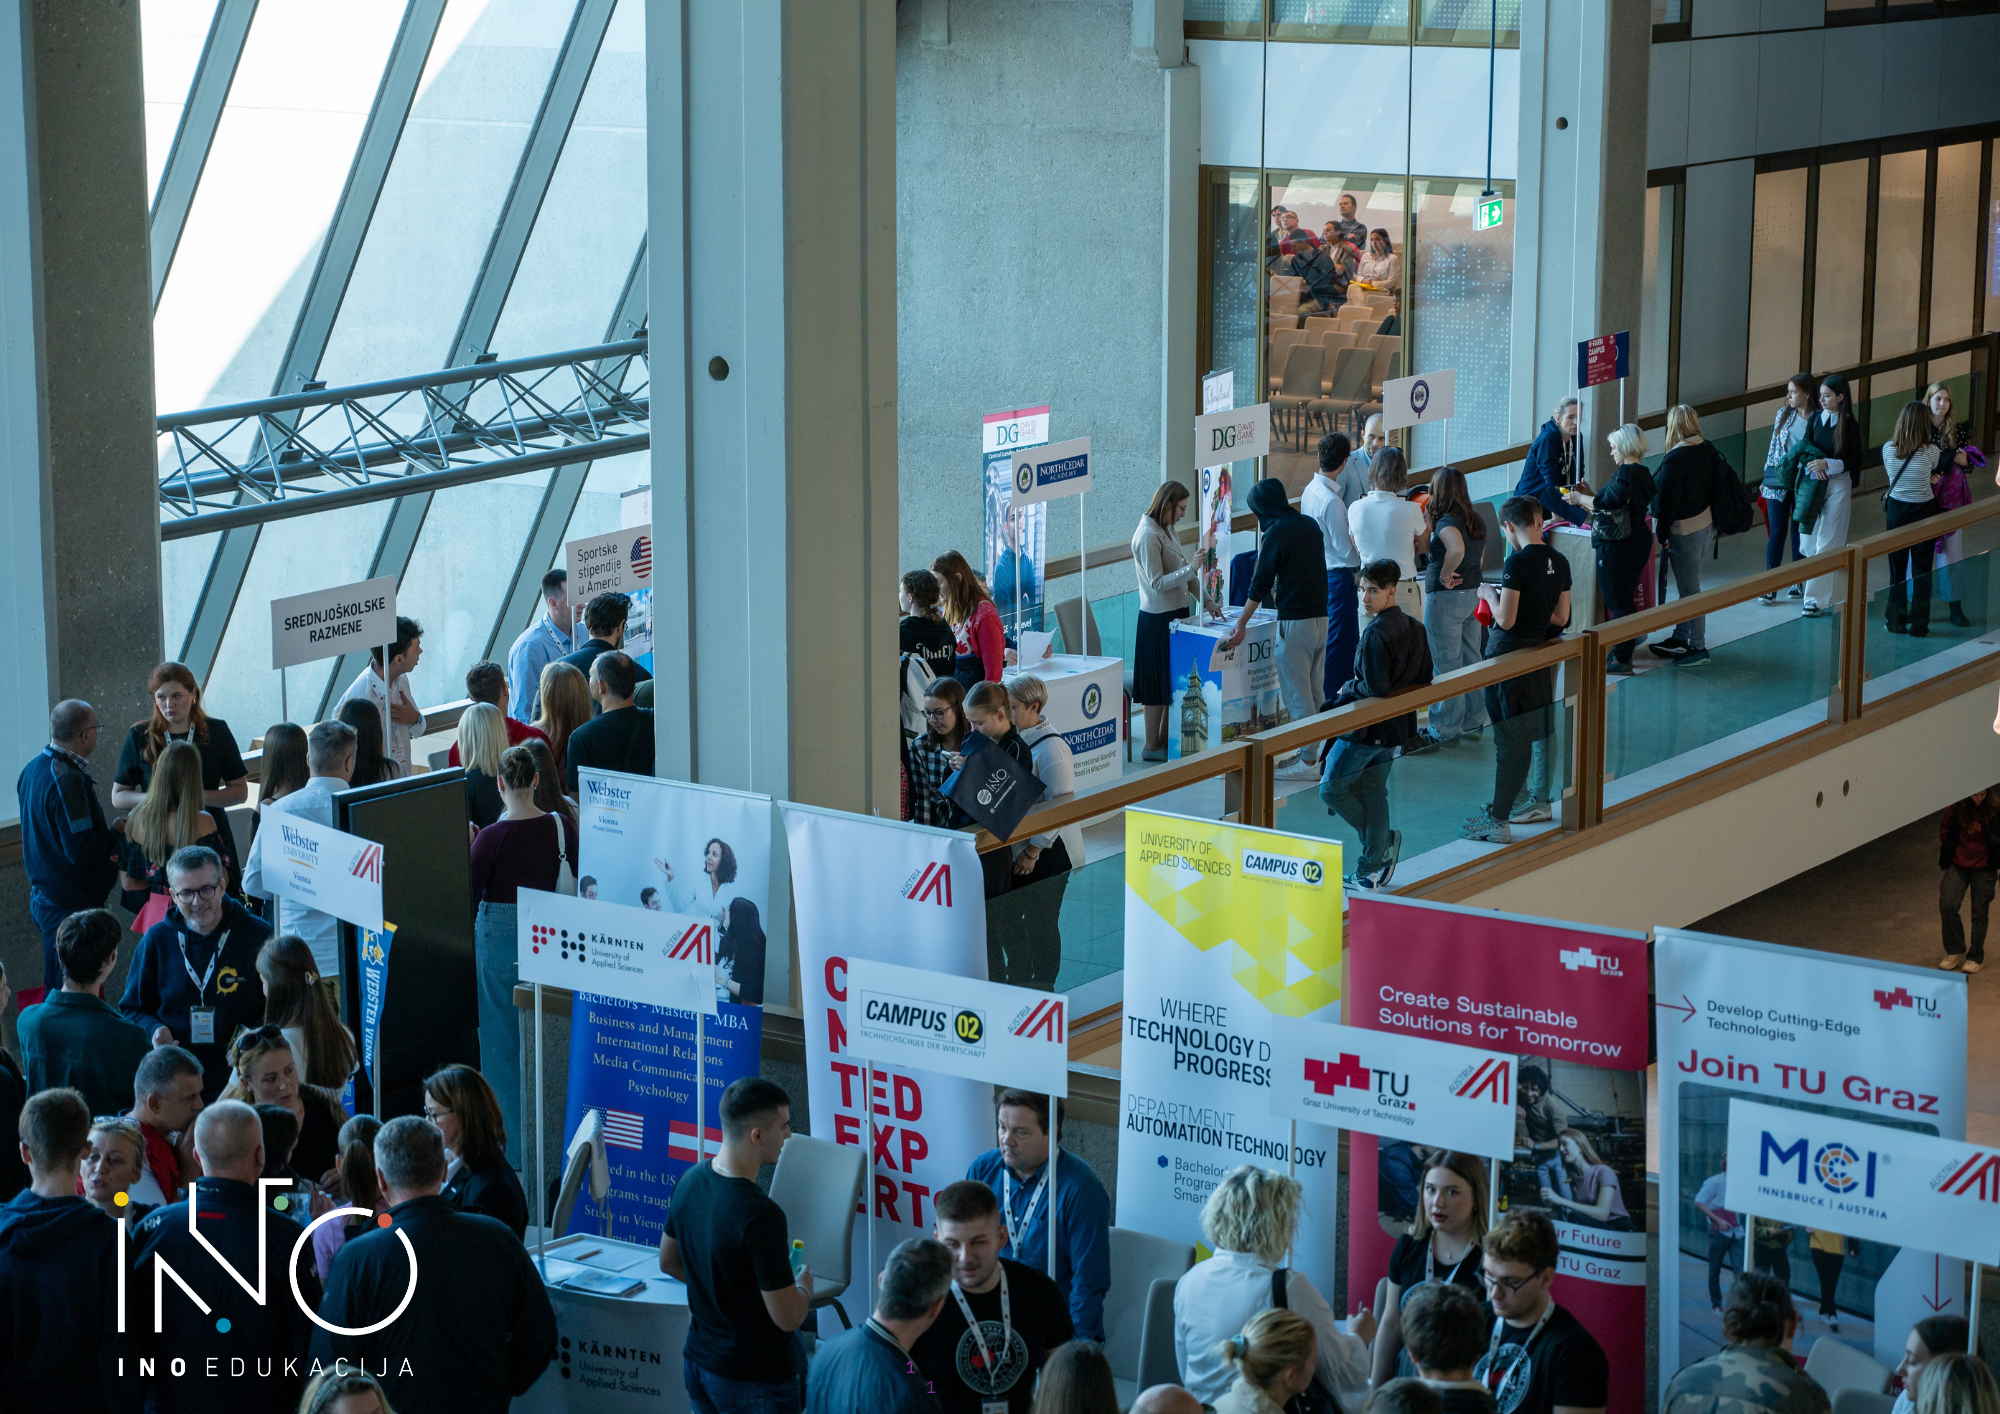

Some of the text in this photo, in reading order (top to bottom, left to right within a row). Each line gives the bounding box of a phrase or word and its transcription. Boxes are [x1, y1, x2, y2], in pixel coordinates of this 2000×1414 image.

[1588, 346, 1605, 356] CAMPUS
[1588, 356, 1598, 364] MAP
[996, 423, 1019, 446] DG
[1211, 425, 1236, 452] DG
[1236, 430, 1255, 441] GAME
[1237, 421, 1255, 432] DAVID
[1050, 470, 1076, 482] ACADEMY
[578, 542, 618, 562] Sportske
[578, 558, 622, 579] stipendije
[578, 573, 622, 596] u Americi
[284, 596, 386, 631] SREDNJOŠKOLSKE
[310, 620, 362, 643] RAZMENE
[1248, 639, 1272, 663] DG
[1076, 737, 1106, 752] ACADEMY
[1073, 755, 1100, 768] nternational
[1074, 768, 1085, 777] hool
[586, 780, 632, 800] Webster
[589, 796, 631, 810] UNIVERSITY
[598, 816, 618, 826] Vienna
[281, 824, 318, 853] Webster
[1140, 831, 1212, 855] UNIVERSITY OF
[283, 844, 319, 866] UNIVERSITY
[348, 848, 362, 874] AUSTRIA
[1139, 849, 1232, 877] APPLIED SCIENCES
[1245, 854, 1320, 881] CAMPUS 02
[293, 870, 311, 885] Vienna
[900, 868, 922, 898] AUSTRIA
[591, 933, 644, 951] KÄRNTEN
[662, 929, 683, 957] AUSTRIA
[591, 948, 630, 962] University of
[591, 958, 644, 974] Applied Sciences
[1596, 956, 1620, 970] TU
[364, 966, 381, 1067] WEBSTER VIENNA
[1160, 996, 1227, 1028] WHERE
[1380, 985, 1578, 1029] Create Sustainable
[1914, 996, 1937, 1012] TU
[1917, 1009, 1936, 1019] Graz
[589, 1011, 733, 1049] Business and Managment
[714, 1012, 749, 1030] MBA
[866, 999, 947, 1032] CAMPUS
[957, 1014, 980, 1040] 02
[1007, 1004, 1032, 1034] AUSTRIA
[1706, 1016, 1796, 1042] Technologies
[1707, 1000, 1860, 1036] Develop Cutting-Edge
[860, 1030, 986, 1059] FACHHOCHSCHULE DER WIRTSCHAFT
[1128, 1015, 1254, 1058] TECHNOLOGY
[1379, 1008, 1622, 1058] Solutions for Tomorrow
[597, 1032, 723, 1067] International Relaons
[593, 1052, 724, 1088] Media Communicaions
[1372, 1068, 1409, 1097] TU
[1448, 1064, 1475, 1096] AUSTRIA
[1678, 1048, 1939, 1115] Join TU Graz
[628, 1079, 689, 1104] Psychology
[830, 1060, 923, 1122] TED
[1377, 1094, 1408, 1110] Graz
[1128, 1093, 1236, 1131] DEPARTMENT
[1303, 1097, 1416, 1126] Graz University of Technology
[834, 1114, 929, 1174] EXP
[1126, 1113, 1327, 1168] AUTOMATION TECHNOLOGY
[626, 1166, 636, 1179] in
[640, 1170, 657, 1183] the
[1759, 1130, 1877, 1198] MCI
[1929, 1158, 1961, 1190] AUSTRIA
[856, 1172, 944, 1230] RT
[1758, 1185, 1825, 1207] INNSBRUCK
[1838, 1202, 1888, 1220] AUSTRIA
[620, 1212, 629, 1224] in
[633, 1214, 664, 1231] Vienn
[1572, 1229, 1621, 1249] Future
[1560, 1257, 1622, 1279] TU Graz
[579, 1340, 661, 1365] KÄRNTEN
[579, 1360, 639, 1380] University of
[580, 1375, 661, 1396] Applied Sciences
